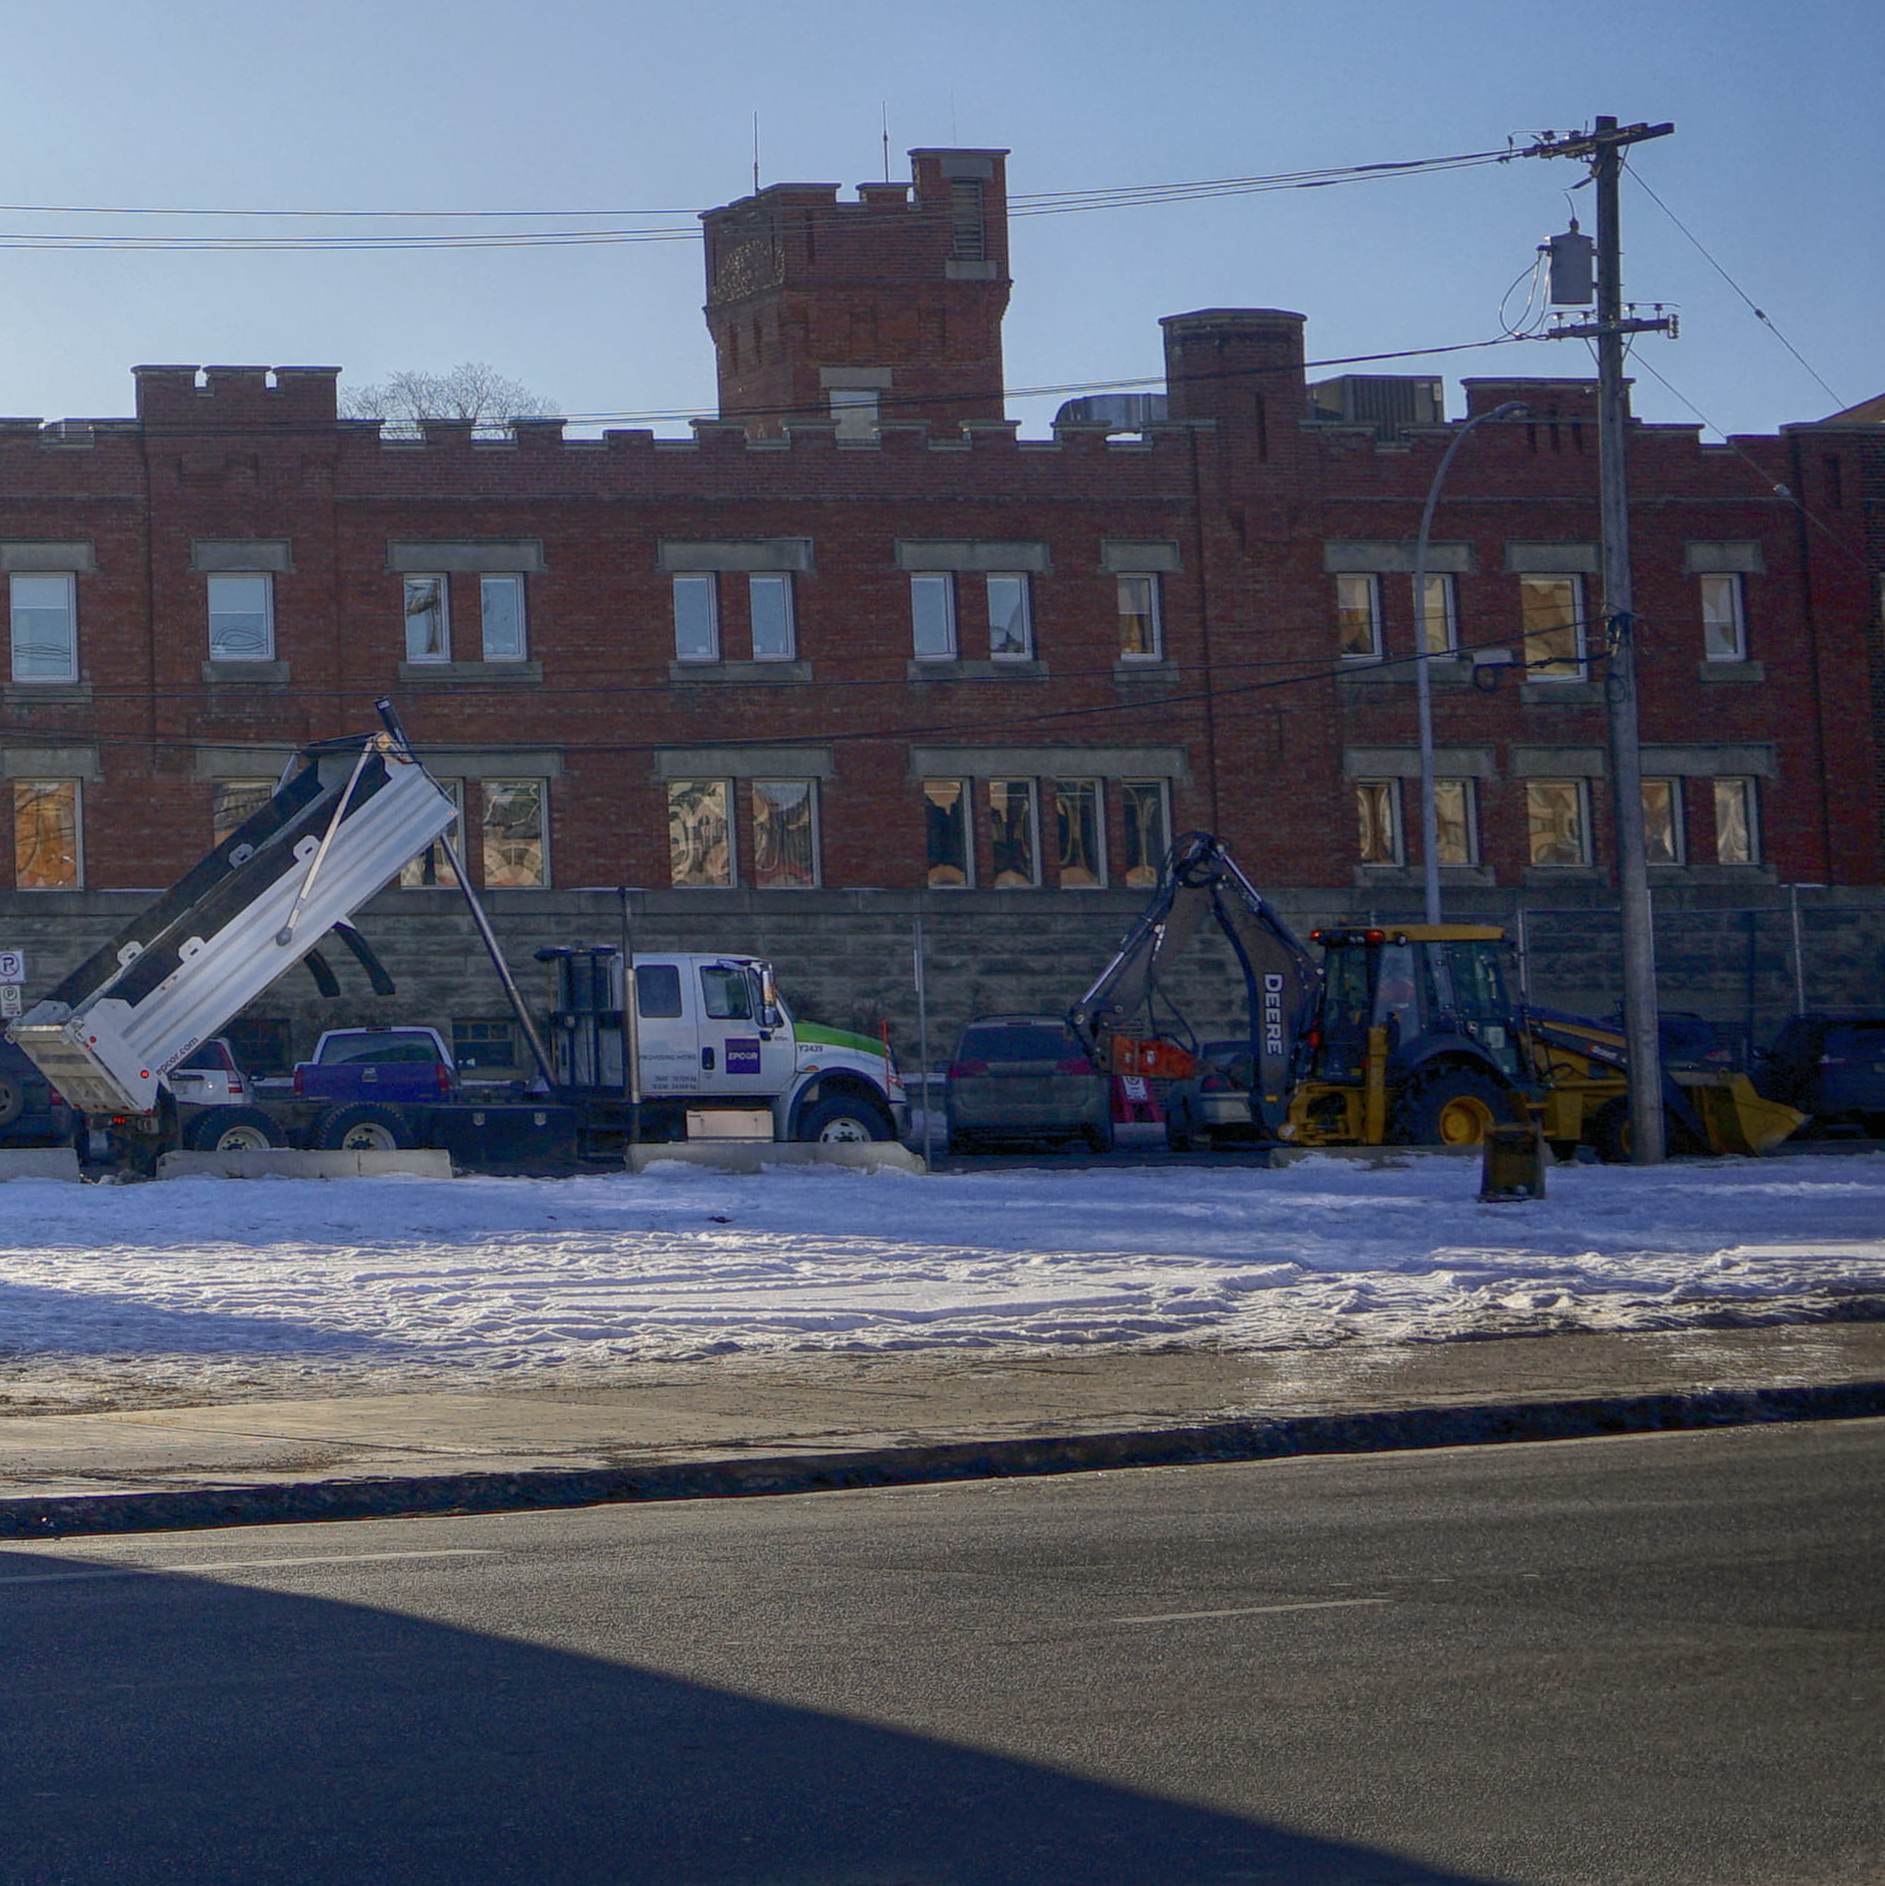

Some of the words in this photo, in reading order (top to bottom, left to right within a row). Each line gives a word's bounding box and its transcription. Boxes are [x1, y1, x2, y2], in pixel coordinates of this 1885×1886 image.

[1264, 974, 1283, 1054] DEERE
[155, 1037, 199, 1076] epcor.com
[727, 1051, 758, 1060] EPCOR
